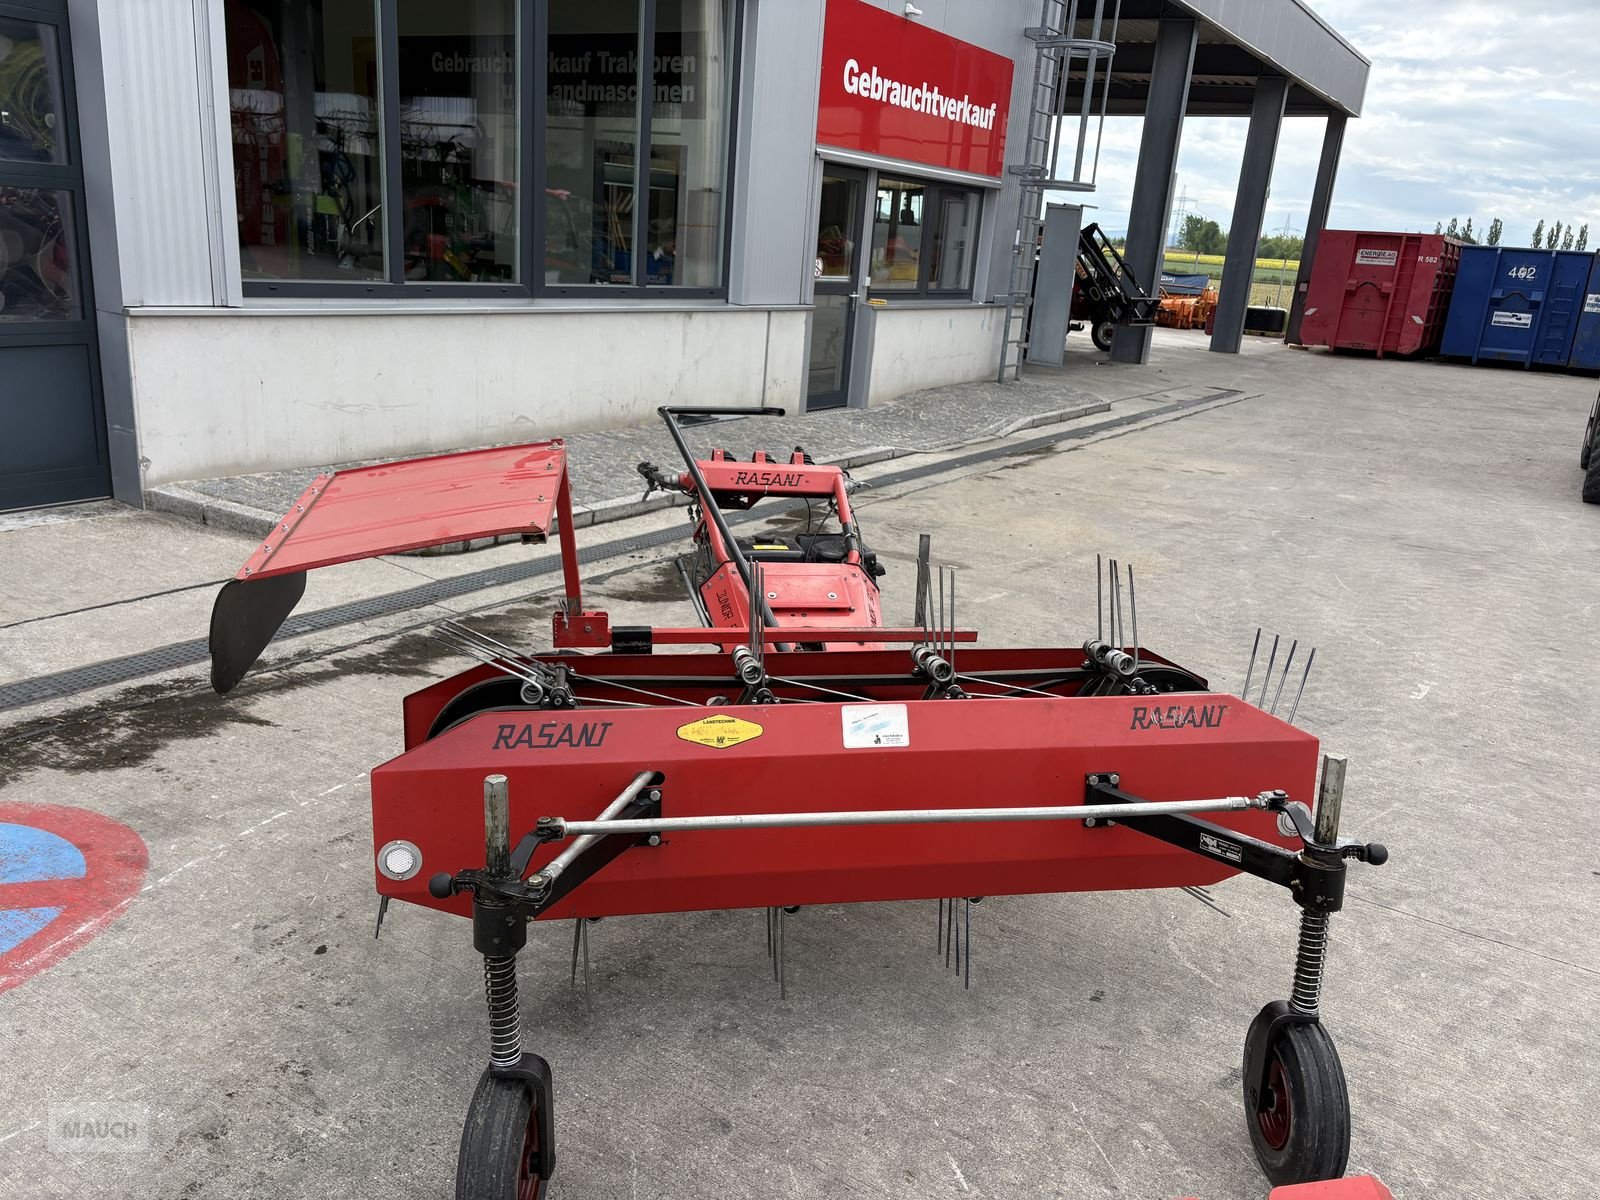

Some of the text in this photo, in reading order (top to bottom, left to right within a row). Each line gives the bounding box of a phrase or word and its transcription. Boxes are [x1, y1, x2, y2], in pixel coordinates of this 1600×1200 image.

[598, 51, 696, 73] Trakoren
[548, 79, 695, 102] andmascinen
[843, 58, 997, 130] Gebrauchtverkauf
[735, 471, 804, 487] RASANT
[715, 589, 733, 620] JUNIOR
[1130, 705, 1228, 730] RASANT
[492, 722, 613, 750] RASANT
